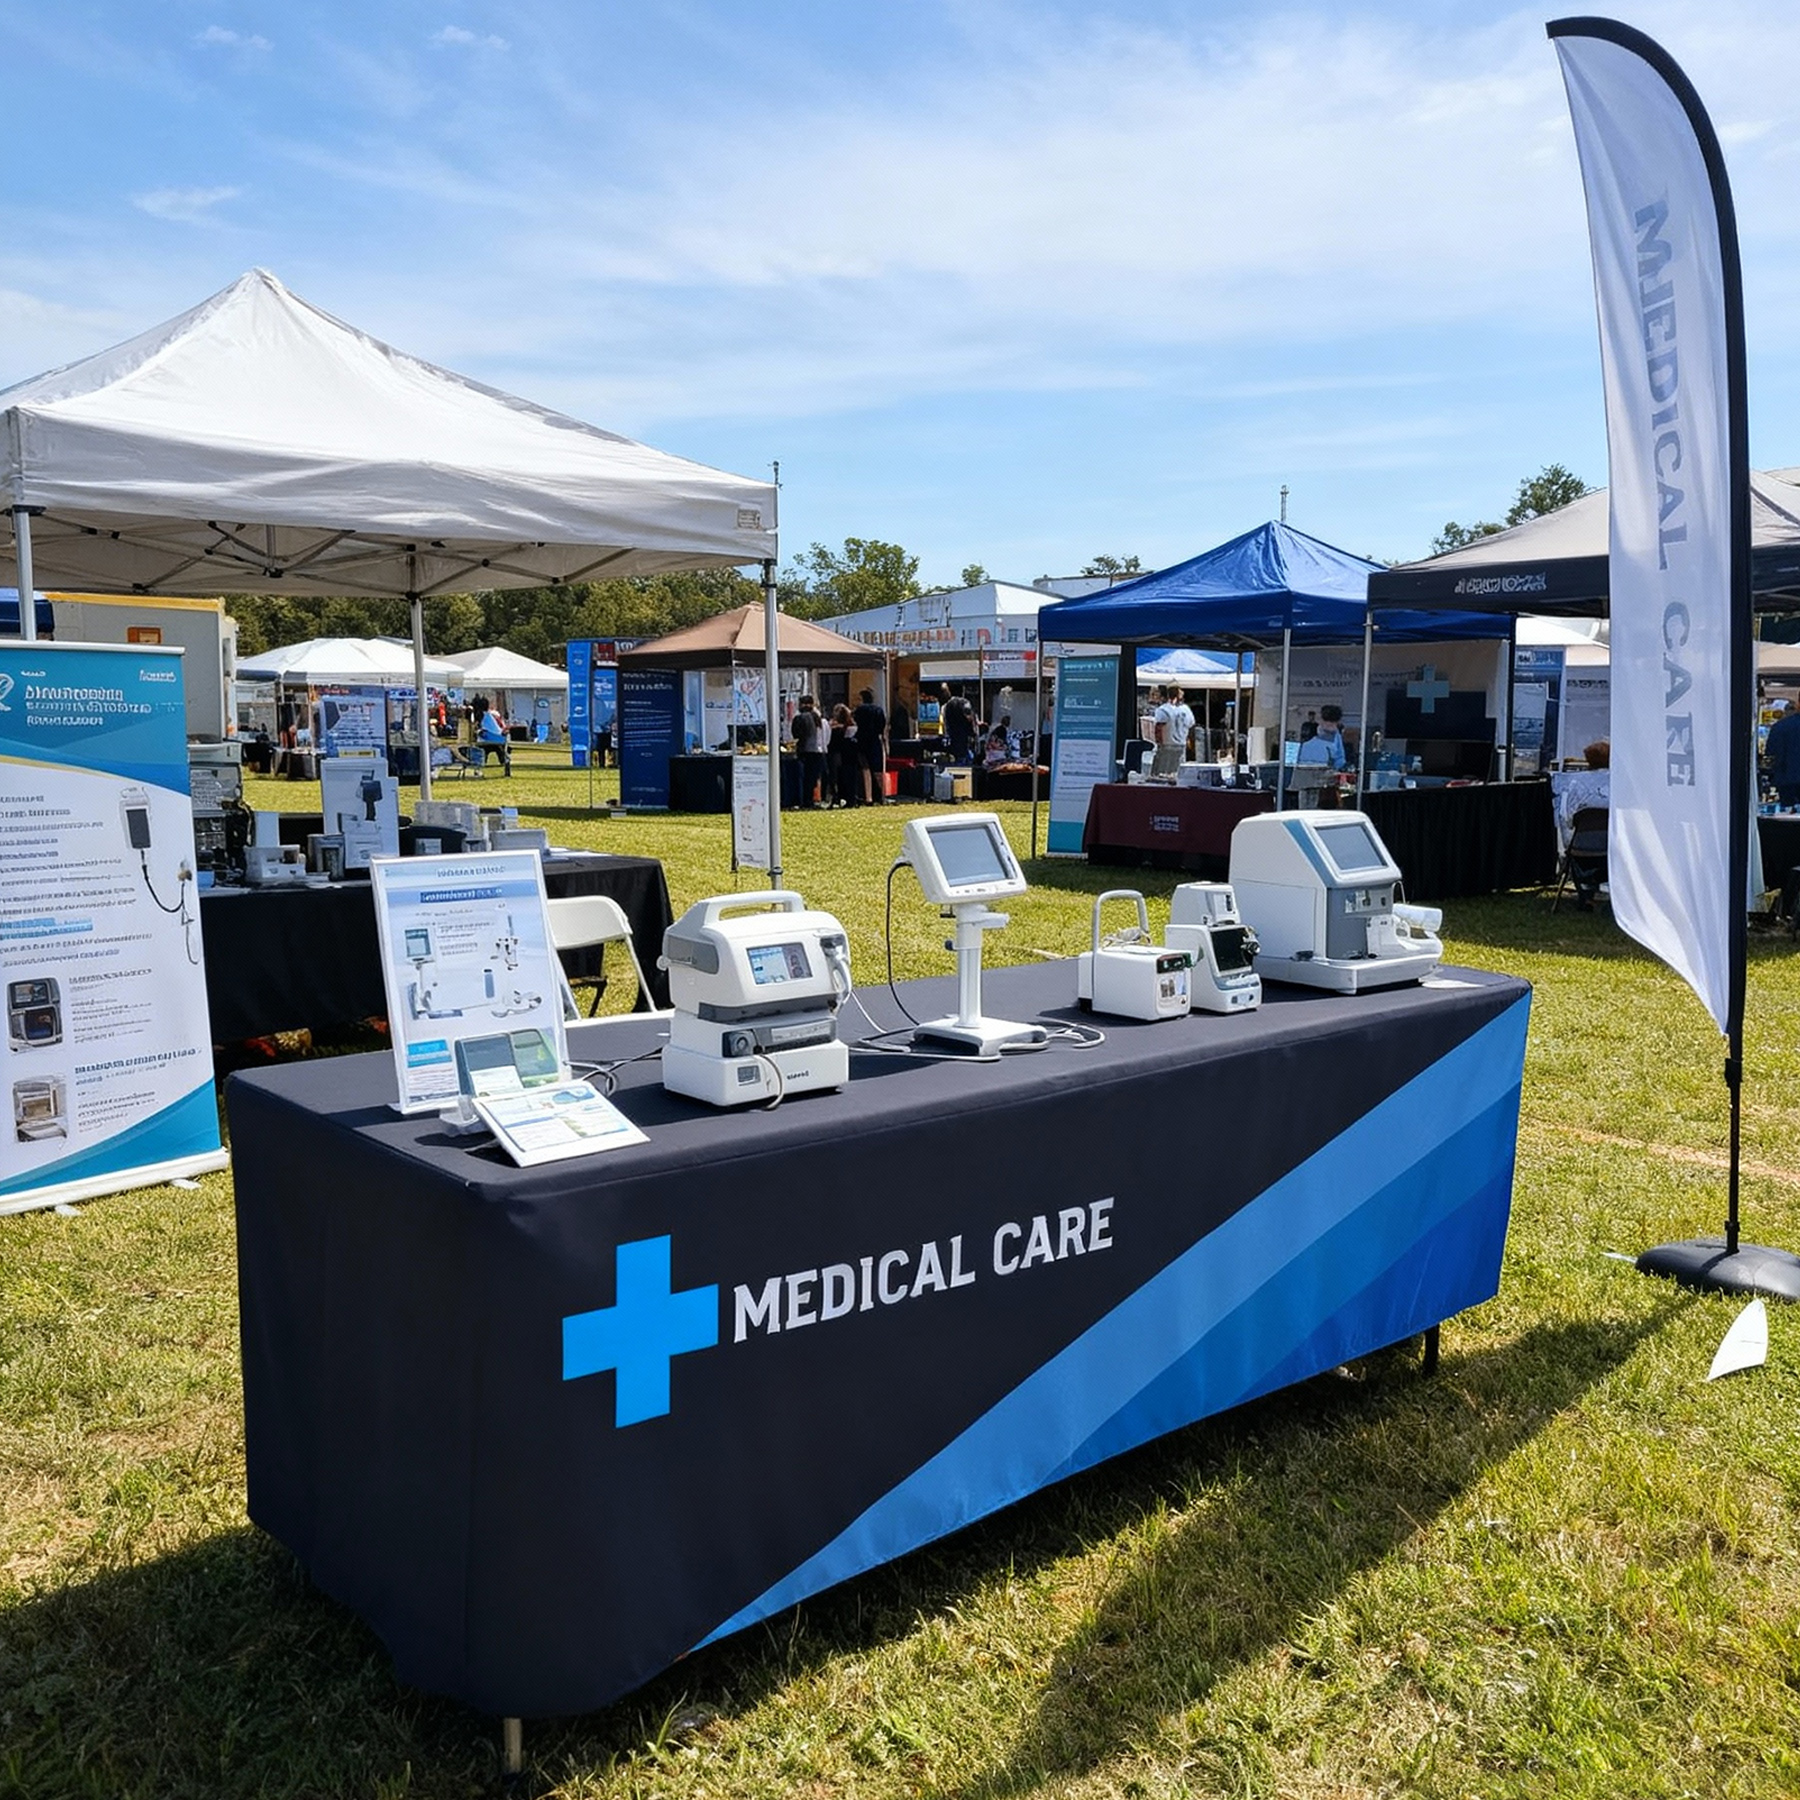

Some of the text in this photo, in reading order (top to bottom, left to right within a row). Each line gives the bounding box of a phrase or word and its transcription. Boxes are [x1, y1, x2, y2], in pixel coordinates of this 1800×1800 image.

[1662, 600, 1697, 788] CARE
[733, 1196, 1115, 1344] MEDICAL CARE
